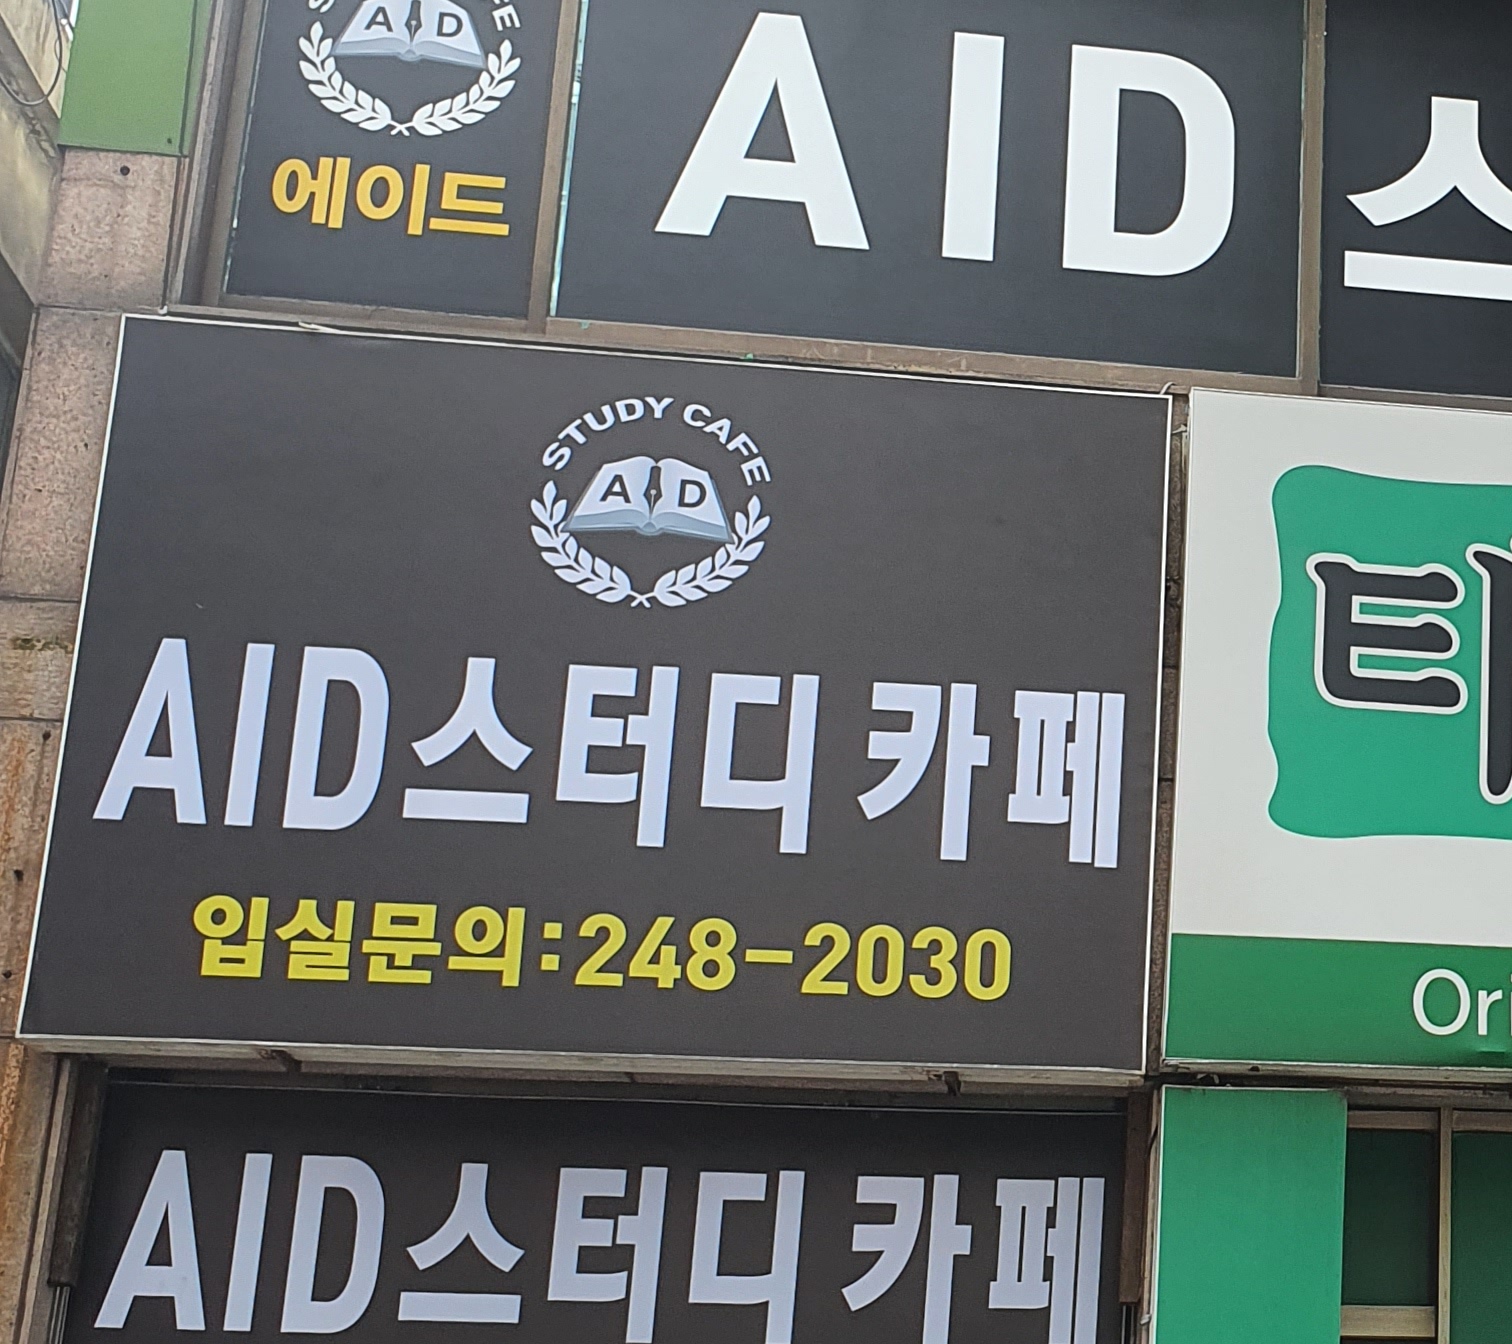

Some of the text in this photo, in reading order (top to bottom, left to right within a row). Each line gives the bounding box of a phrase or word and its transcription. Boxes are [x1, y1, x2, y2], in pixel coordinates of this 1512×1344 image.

[272, 156, 511, 236] 에이드
[541, 396, 770, 487] STUDY CAFE
[857, 681, 1126, 868] 카페
